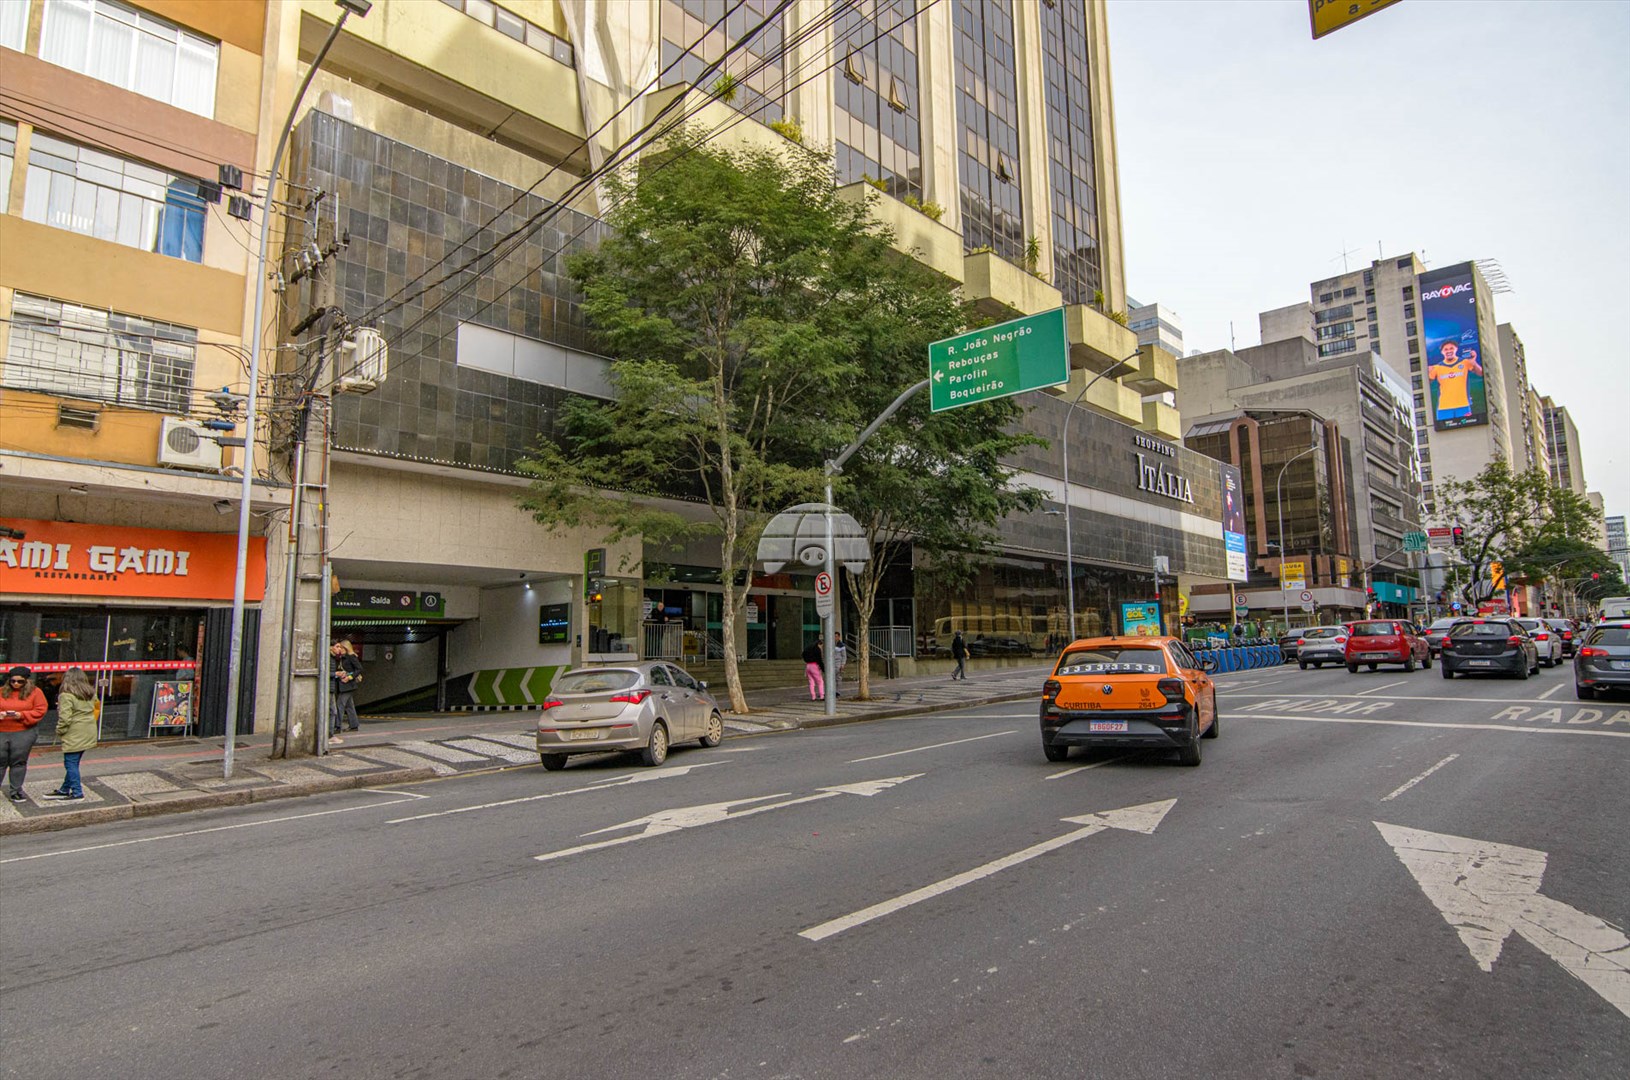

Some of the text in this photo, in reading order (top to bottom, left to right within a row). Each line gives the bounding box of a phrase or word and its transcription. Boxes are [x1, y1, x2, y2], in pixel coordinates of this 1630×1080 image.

[1422, 282, 1472, 301] RAYOVAC
[948, 326, 1032, 355] R. João Negrão
[948, 351, 999, 370] Rebouças
[949, 368, 988, 384] Parolin
[950, 380, 1004, 399] Boqueirão
[1135, 435, 1175, 457] SHOPPING
[1136, 452, 1194, 503] ITÁLIA
[86, 546, 190, 576] GAMI
[34, 571, 118, 581] RESTAURANTE
[1232, 699, 1395, 715] RADAR
